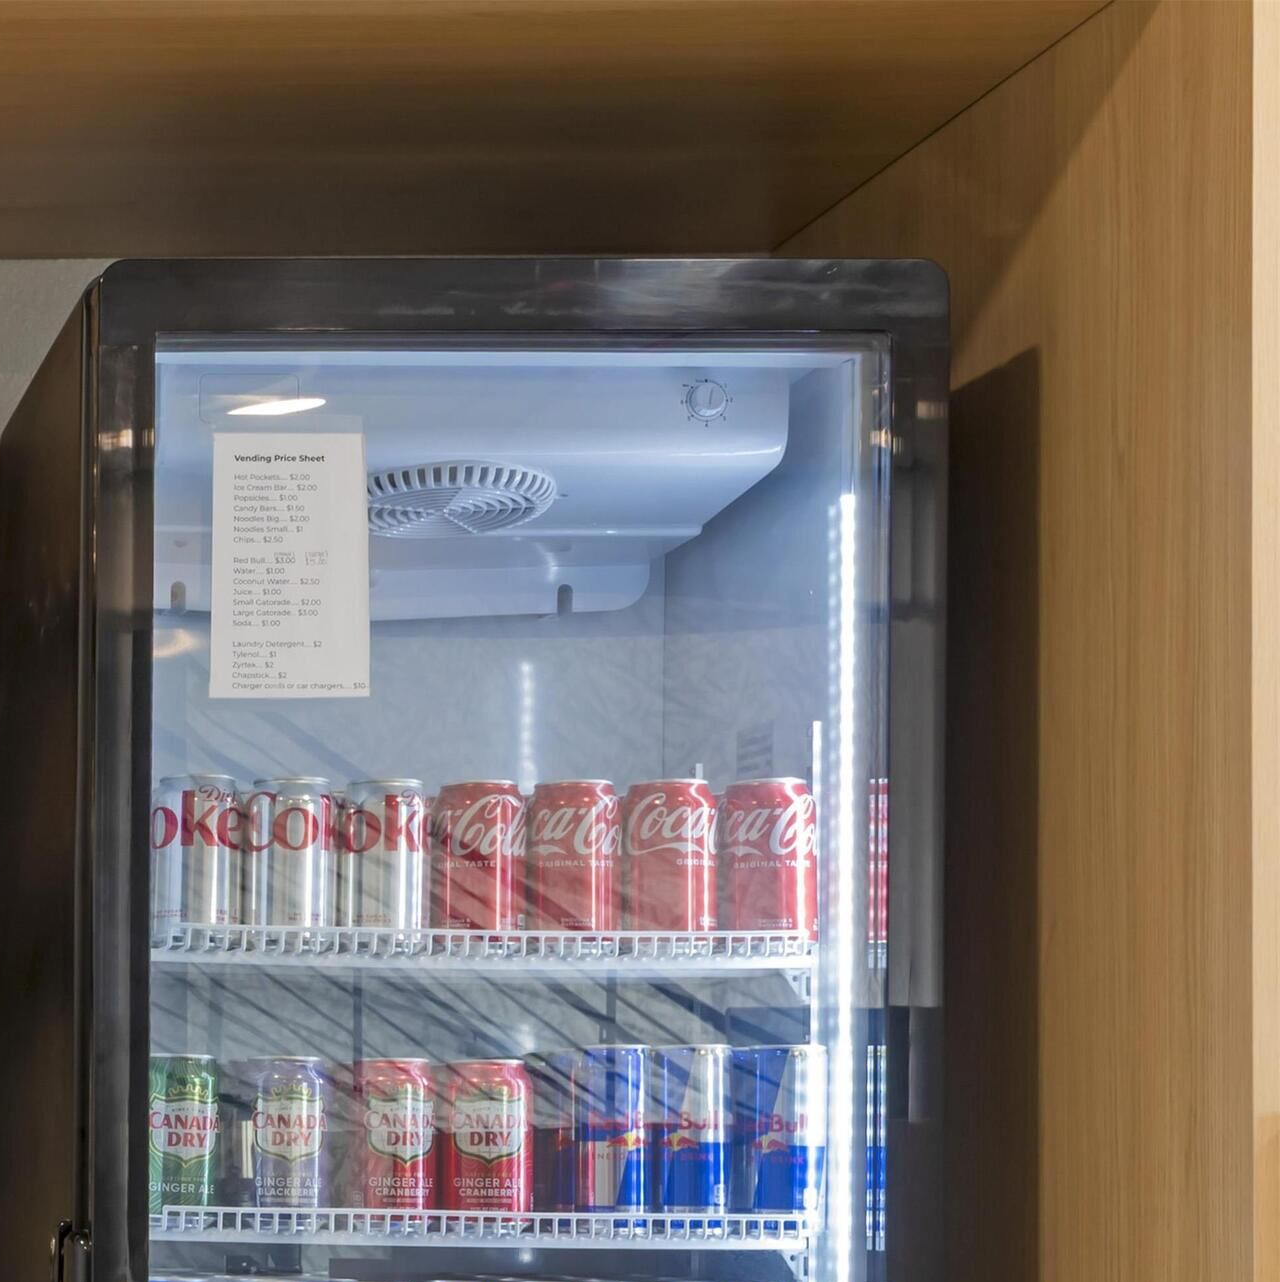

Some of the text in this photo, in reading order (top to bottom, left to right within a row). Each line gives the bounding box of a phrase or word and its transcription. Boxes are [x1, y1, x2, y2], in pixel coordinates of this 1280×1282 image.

[234, 455, 271, 463] Vending
[252, 1111, 328, 1132] CANADA
[451, 1111, 529, 1132] CANADA
[271, 1131, 311, 1147] DRY
[469, 1131, 511, 1147] DRY
[453, 1176, 521, 1188] GINGER ALE
[458, 1188, 520, 1197] CRANBERRY
